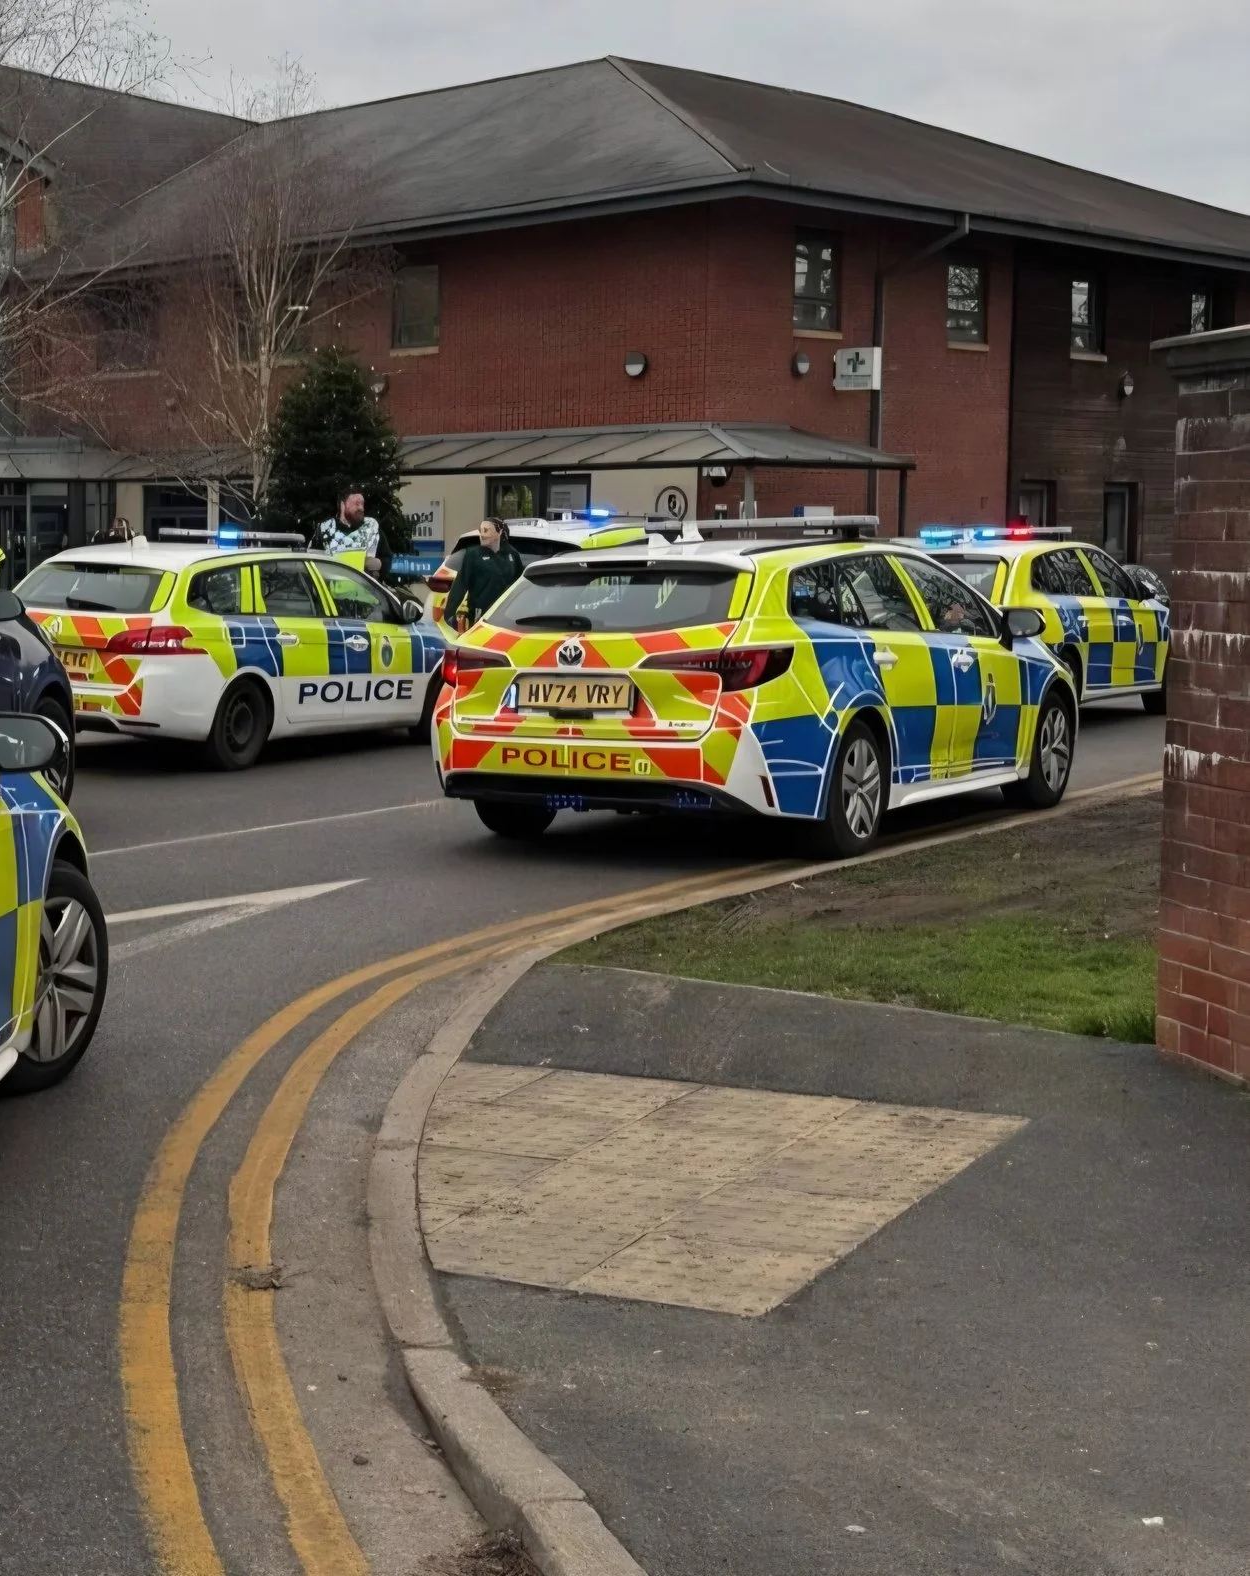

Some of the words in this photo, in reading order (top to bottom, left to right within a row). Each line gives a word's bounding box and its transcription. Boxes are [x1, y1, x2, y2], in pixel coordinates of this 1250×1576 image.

[298, 679, 414, 705] POLICE
[528, 683, 577, 703] HV74
[586, 684, 624, 704] VRY
[501, 747, 631, 773] POLICE
